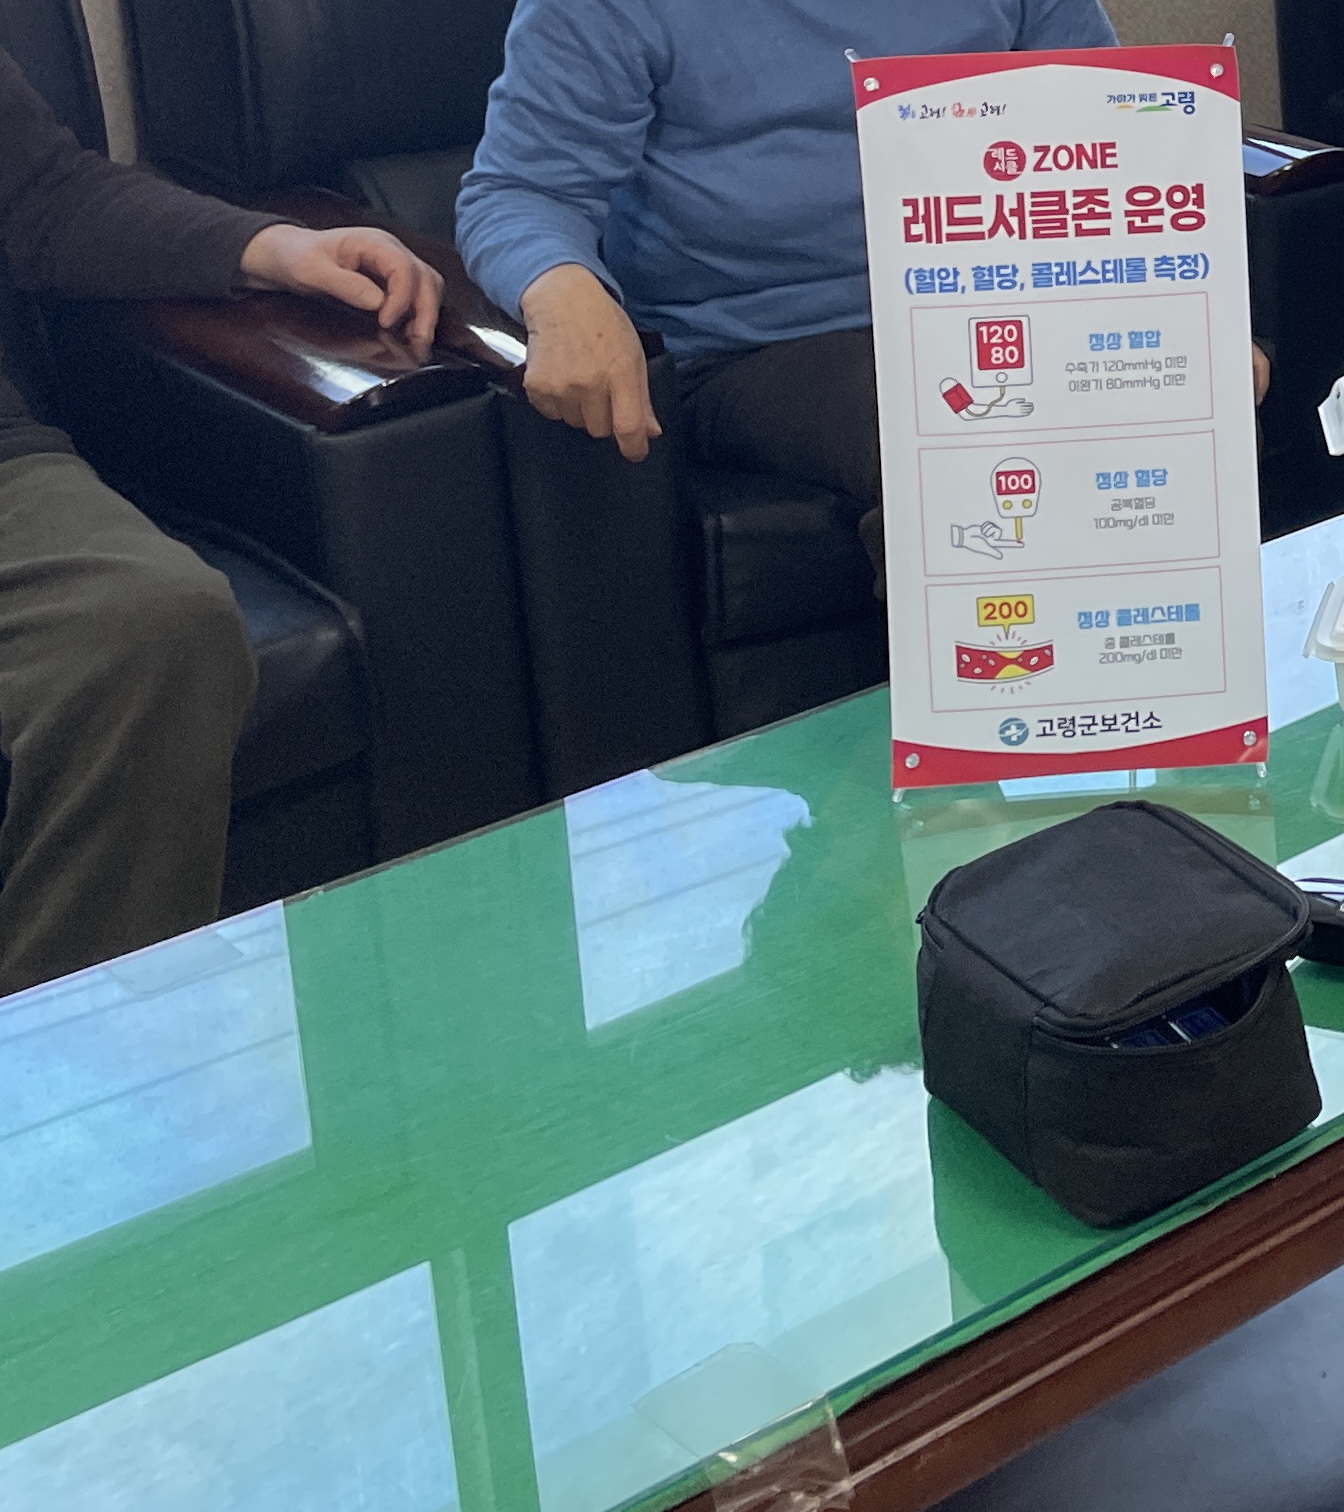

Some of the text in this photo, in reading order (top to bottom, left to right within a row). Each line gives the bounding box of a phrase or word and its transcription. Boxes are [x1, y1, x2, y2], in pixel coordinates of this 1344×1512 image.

[1159, 91, 1196, 115] 고령
[1032, 142, 1118, 172] ZONE
[902, 183, 1206, 245] 레드서클존 운영
[904, 253, 1210, 296] (혈압, 혈당, 콜레스테롤 측정)
[978, 325, 1018, 344] 120
[1089, 330, 1161, 351] 정상 혈압
[990, 346, 1019, 364] 80
[1102, 358, 1162, 372] 120mmHg
[1164, 356, 1187, 368] 미만
[1106, 377, 1161, 390] 80mmHg
[1163, 374, 1186, 387] 미만
[998, 474, 1032, 491] 100
[1096, 468, 1168, 490] 정상 혈당
[1093, 513, 1175, 530] 100mg/dl 미만
[983, 602, 1028, 619] 200
[1077, 611, 1110, 629] 정상
[1099, 648, 1182, 664] 200mg/dl 미만
[1035, 711, 1163, 739] 고령군보건소
